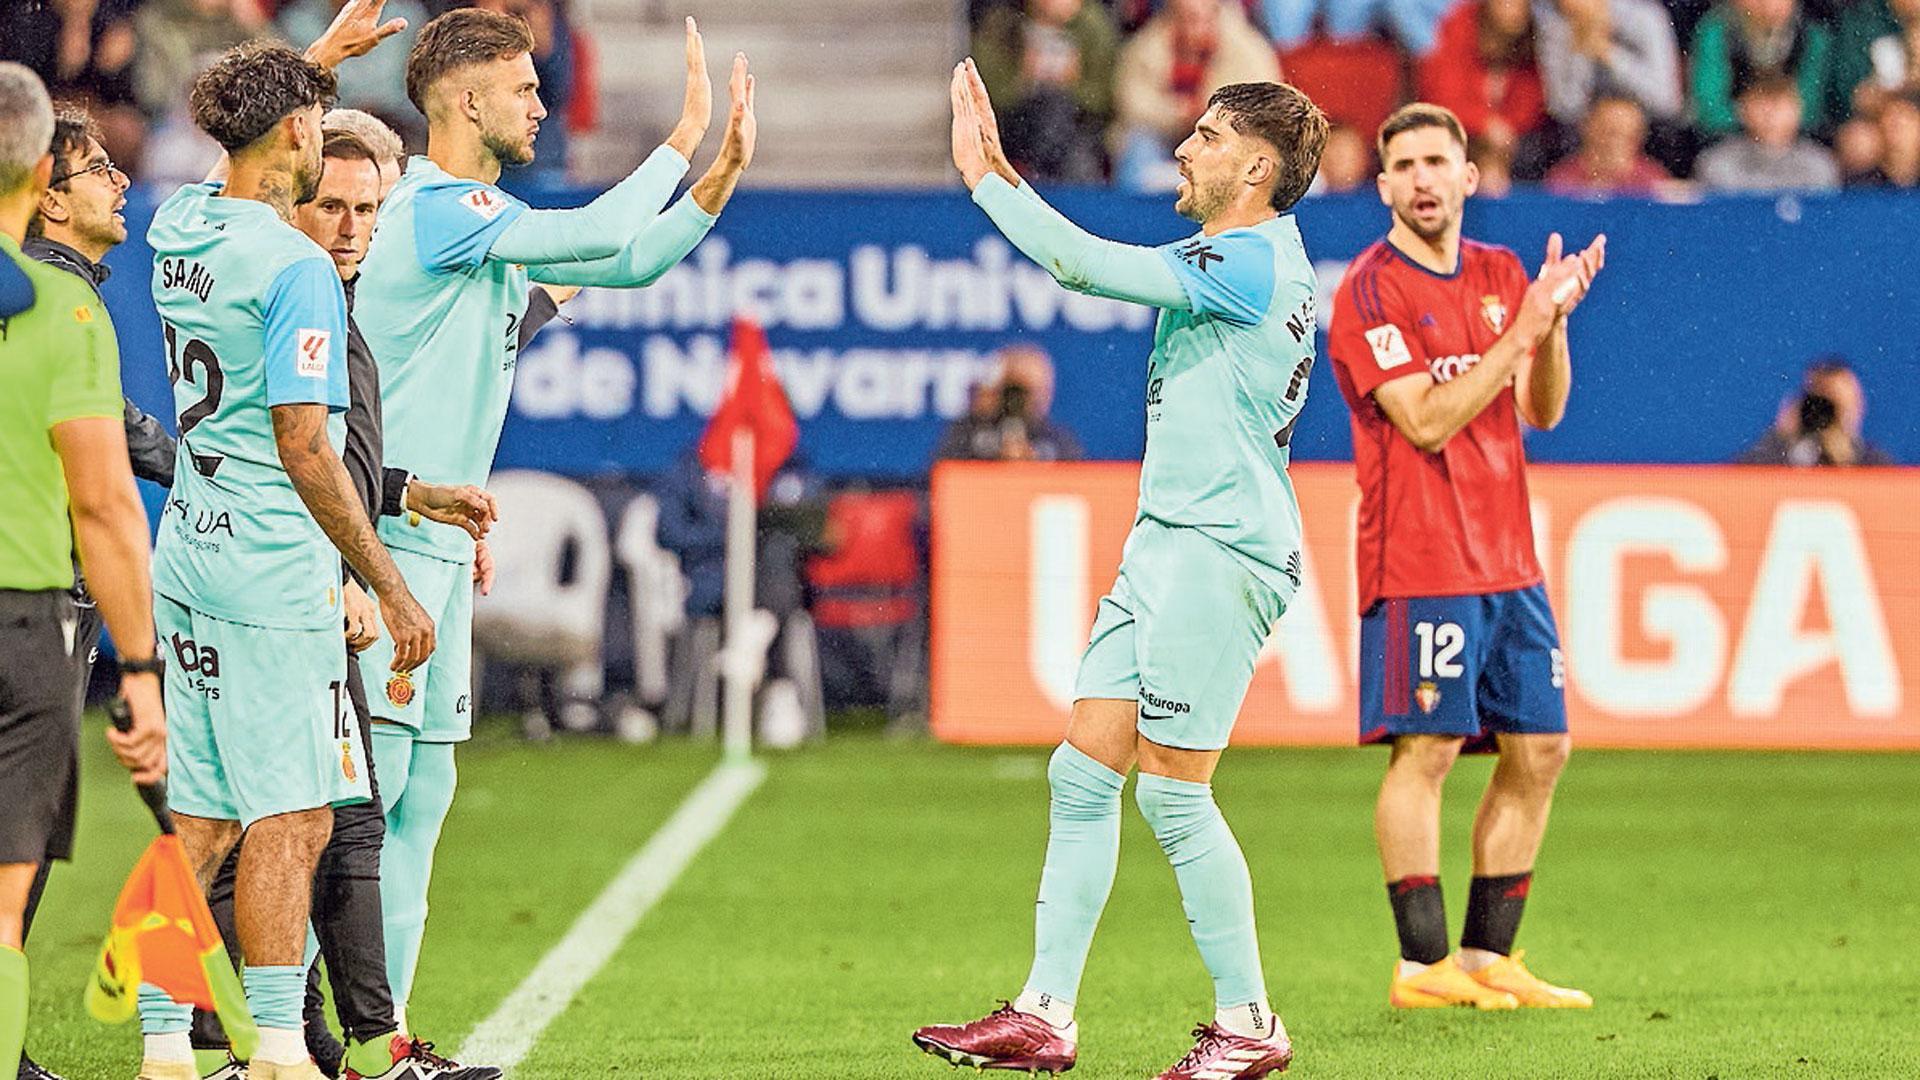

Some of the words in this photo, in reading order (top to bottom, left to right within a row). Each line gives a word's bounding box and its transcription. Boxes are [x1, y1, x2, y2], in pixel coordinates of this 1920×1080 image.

[163, 258, 215, 303] SAMU
[515, 332, 638, 419] de
[1414, 621, 1465, 678] 12
